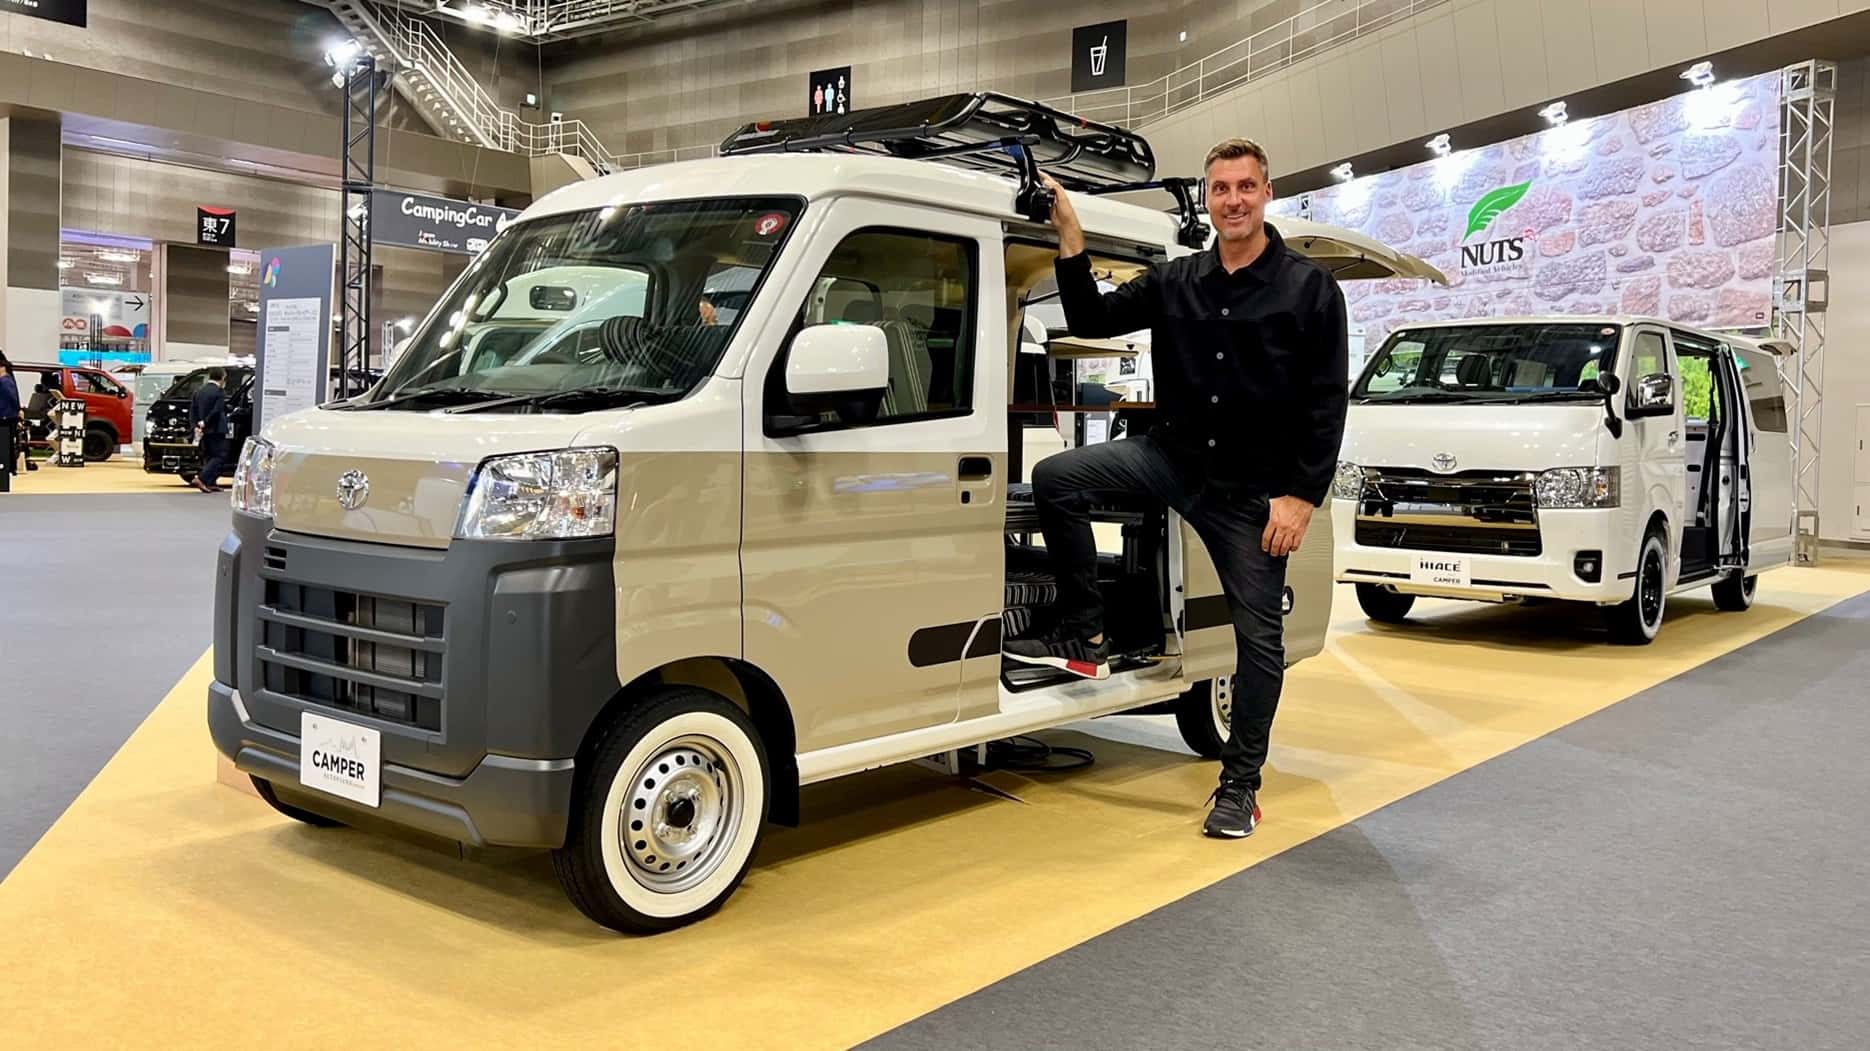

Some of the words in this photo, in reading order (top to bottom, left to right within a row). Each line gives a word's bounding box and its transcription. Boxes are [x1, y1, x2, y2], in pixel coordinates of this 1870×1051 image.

[401, 197, 493, 228] CampingCar
[1461, 237, 1524, 268] NUTS
[61, 401, 86, 410] NEW
[1420, 561, 1461, 571] HIACE
[312, 750, 365, 780] CAMPER
